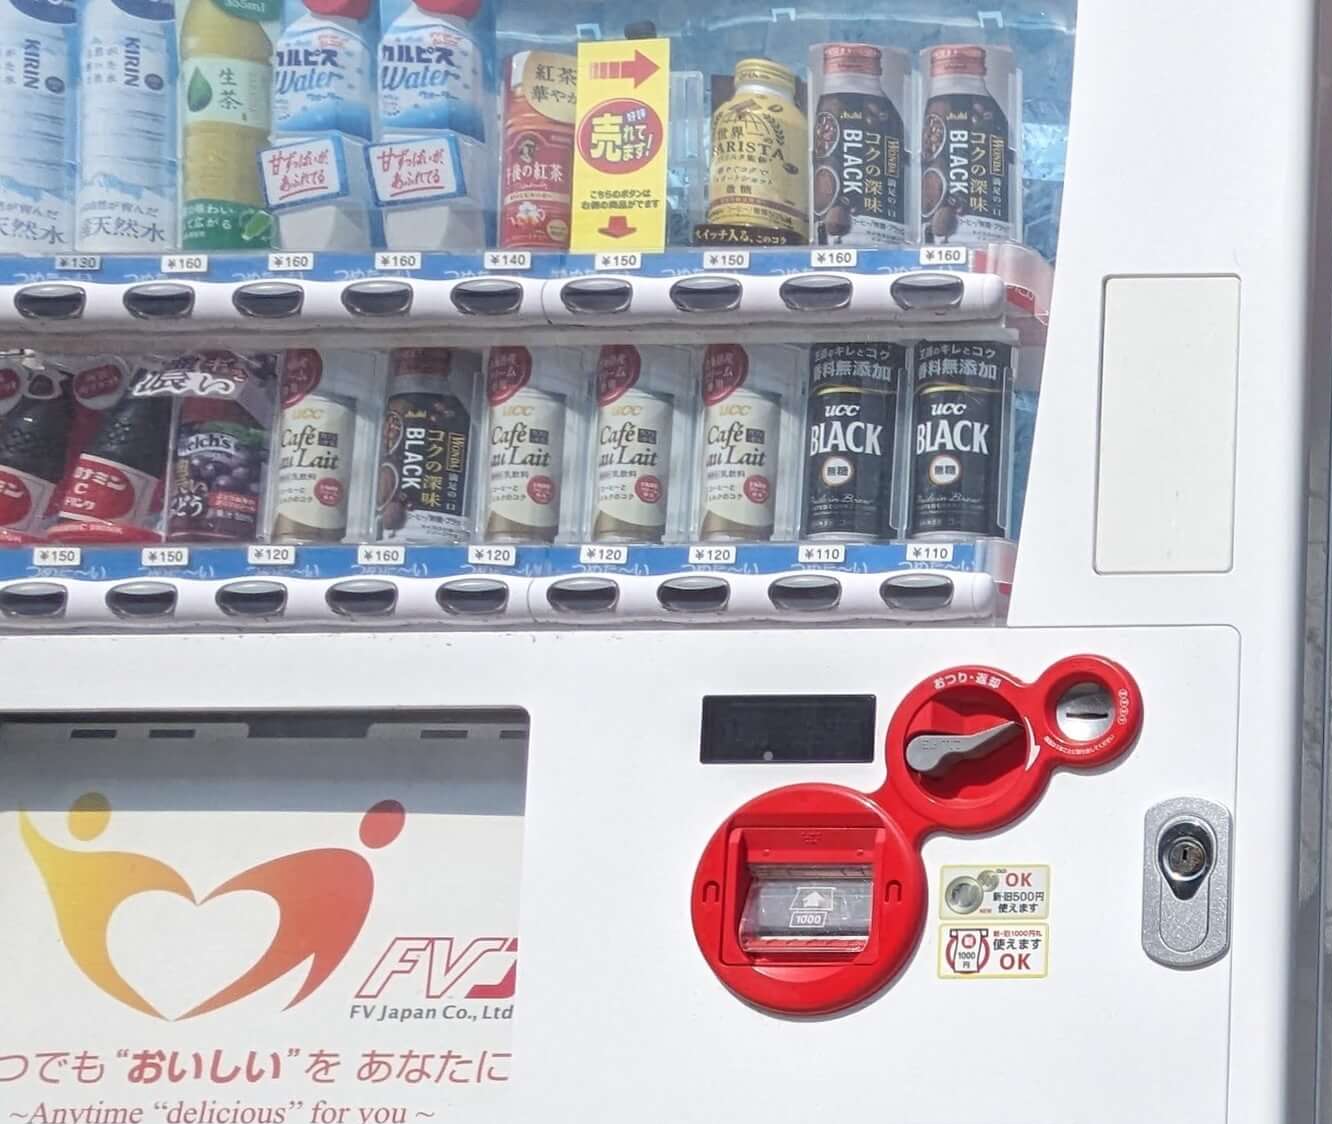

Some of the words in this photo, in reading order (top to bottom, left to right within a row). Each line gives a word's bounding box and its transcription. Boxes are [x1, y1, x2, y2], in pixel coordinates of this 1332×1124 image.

[24, 39, 41, 89] KIRIN
[124, 37, 140, 87] KIRIN
[381, 65, 460, 91] Water
[219, 67, 243, 109] 生茶
[843, 128, 864, 195] BLACK
[949, 129, 969, 195] BLACK
[92, 215, 165, 242] 天然水
[274, 256, 309, 267] ¥160
[381, 255, 416, 266] ¥160
[490, 255, 526, 266] ¥140
[602, 255, 637, 266] ¥150
[709, 255, 744, 266] ¥150
[817, 252, 852, 263] ¥160
[926, 249, 961, 261] ¥160
[60, 257, 96, 268] ¥130
[168, 258, 201, 269] ¥160
[281, 424, 316, 452] Café
[492, 421, 528, 450] Café
[601, 421, 636, 449] Café
[707, 420, 744, 450] Café
[809, 419, 884, 456] BLACK
[916, 418, 991, 455] BLACK
[187, 434, 232, 451] elch's
[296, 448, 340, 470] Lait
[401, 428, 426, 490] BLACK
[509, 446, 551, 467] Lait
[617, 446, 659, 466] Lait
[724, 445, 767, 466] Lait
[74, 482, 89, 494] C
[40, 551, 75, 562] ¥150
[149, 551, 183, 562] ¥150
[254, 548, 289, 560] ¥120
[364, 550, 400, 561] ¥160
[475, 550, 510, 561] ¥120
[586, 549, 622, 560] ¥120
[696, 549, 730, 560] ¥120
[804, 549, 840, 560] ¥110
[912, 547, 949, 559] ¥110
[1006, 873, 1032, 887] OK
[998, 904, 1039, 914] 使えます
[796, 914, 822, 925] 1000
[993, 938, 1042, 951] 使えます
[958, 951, 976, 960] 1000
[1000, 953, 1031, 970] OK
[350, 1005, 376, 1019] FV
[377, 1005, 437, 1022] Japan
[442, 1005, 477, 1021] Co.,
[482, 1004, 514, 1020] Ltd
[356, 1049, 513, 1084] あなたに
[310, 1101, 350, 1124] for
